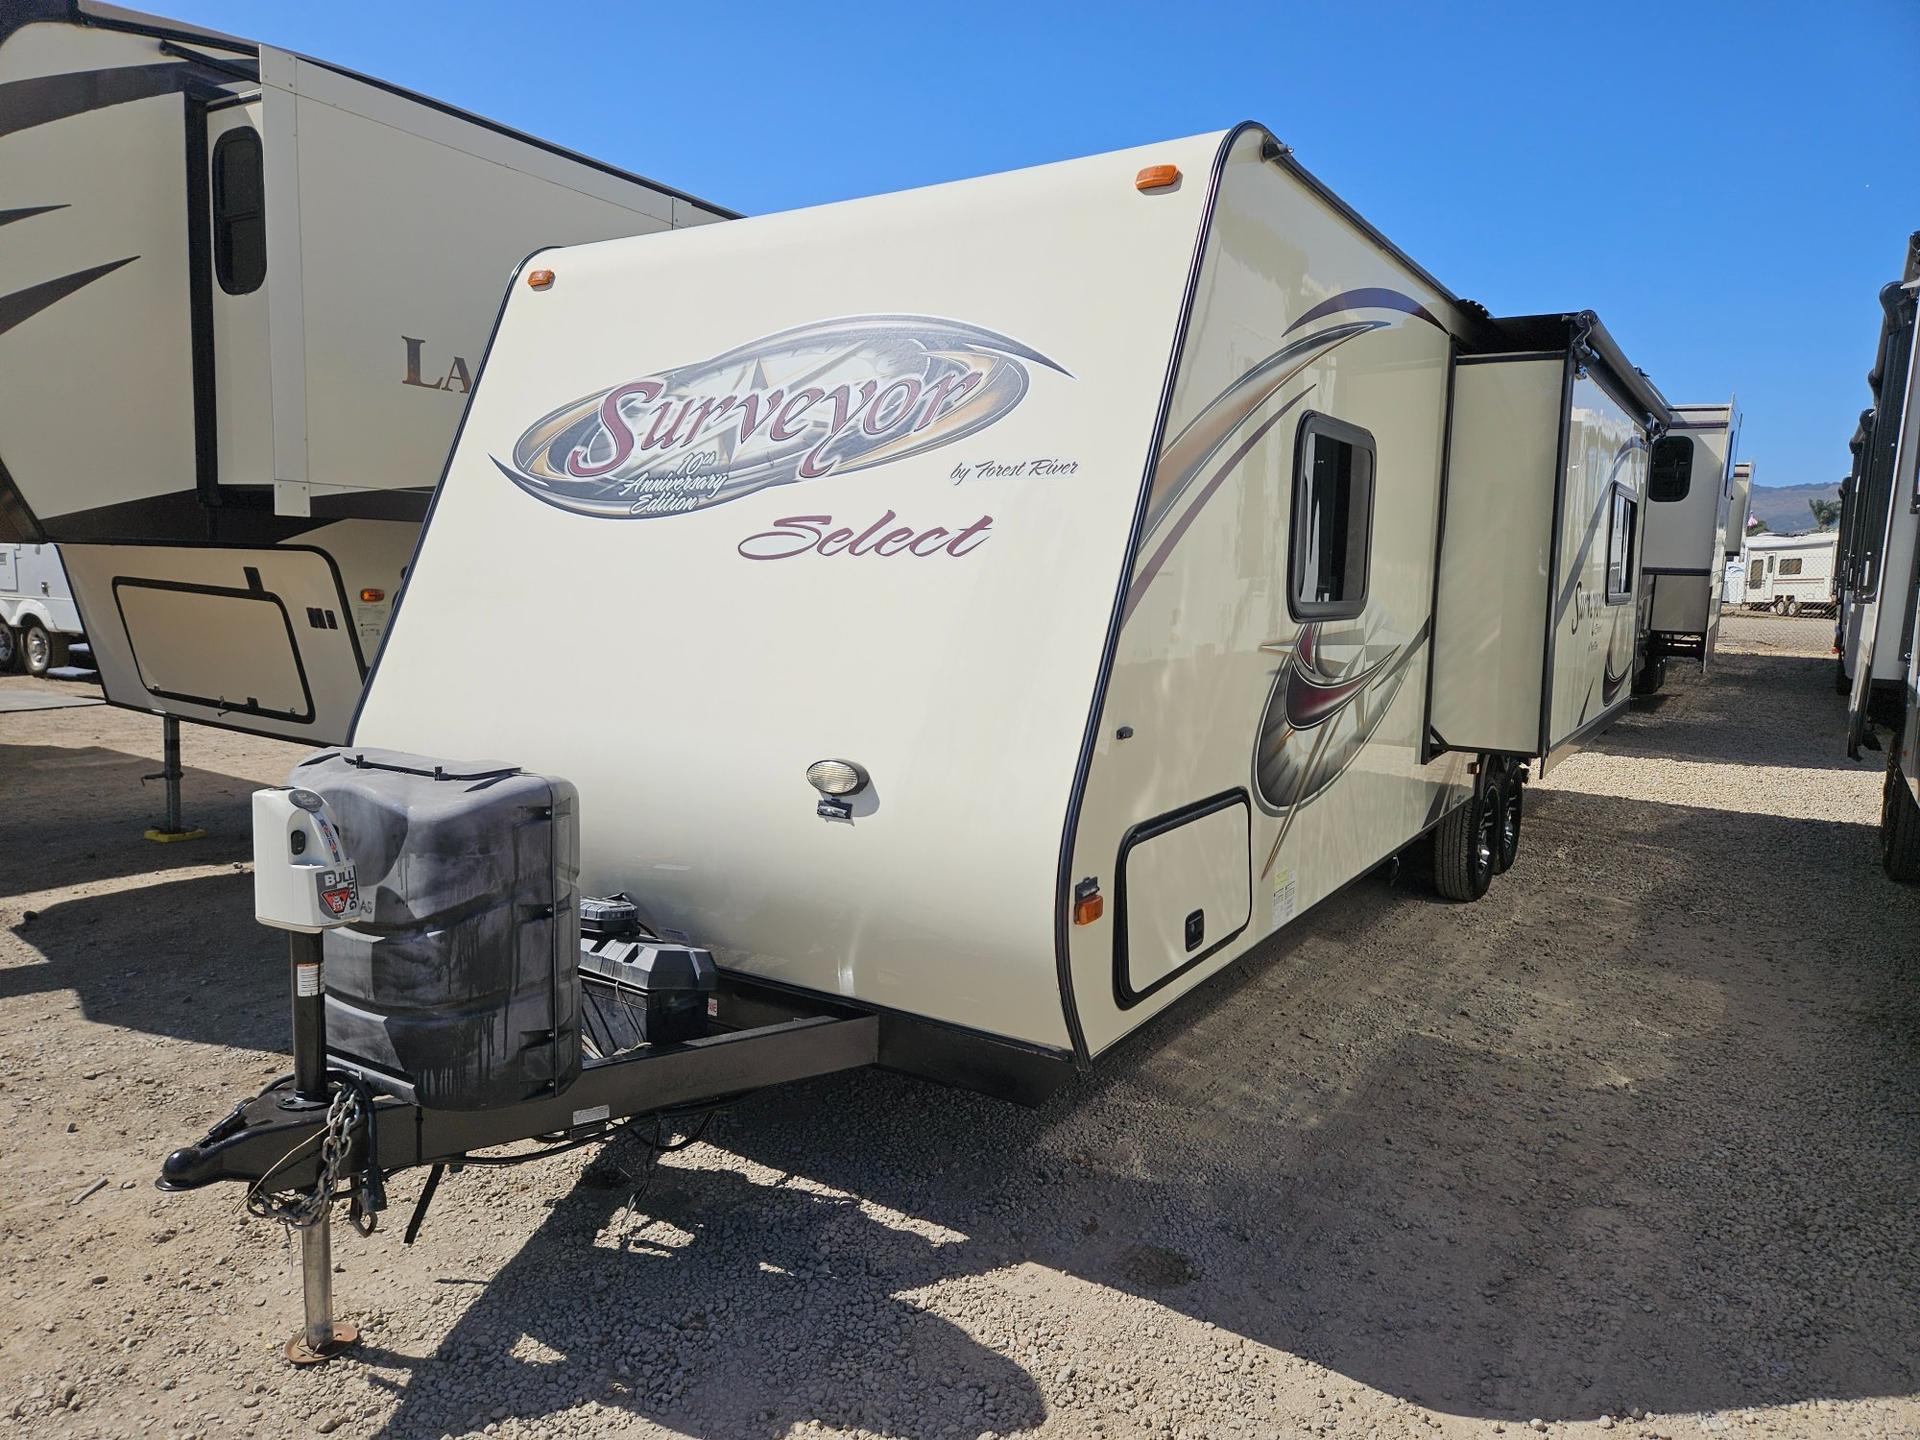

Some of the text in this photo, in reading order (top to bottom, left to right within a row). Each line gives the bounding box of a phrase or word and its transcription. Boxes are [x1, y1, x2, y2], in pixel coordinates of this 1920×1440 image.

[568, 370, 982, 477] Surveyor
[677, 451, 716, 474] 10th
[950, 459, 1078, 486] by Forest River
[619, 472, 728, 499] Anniversary
[631, 491, 698, 514] Edition
[738, 509, 993, 560] Select
